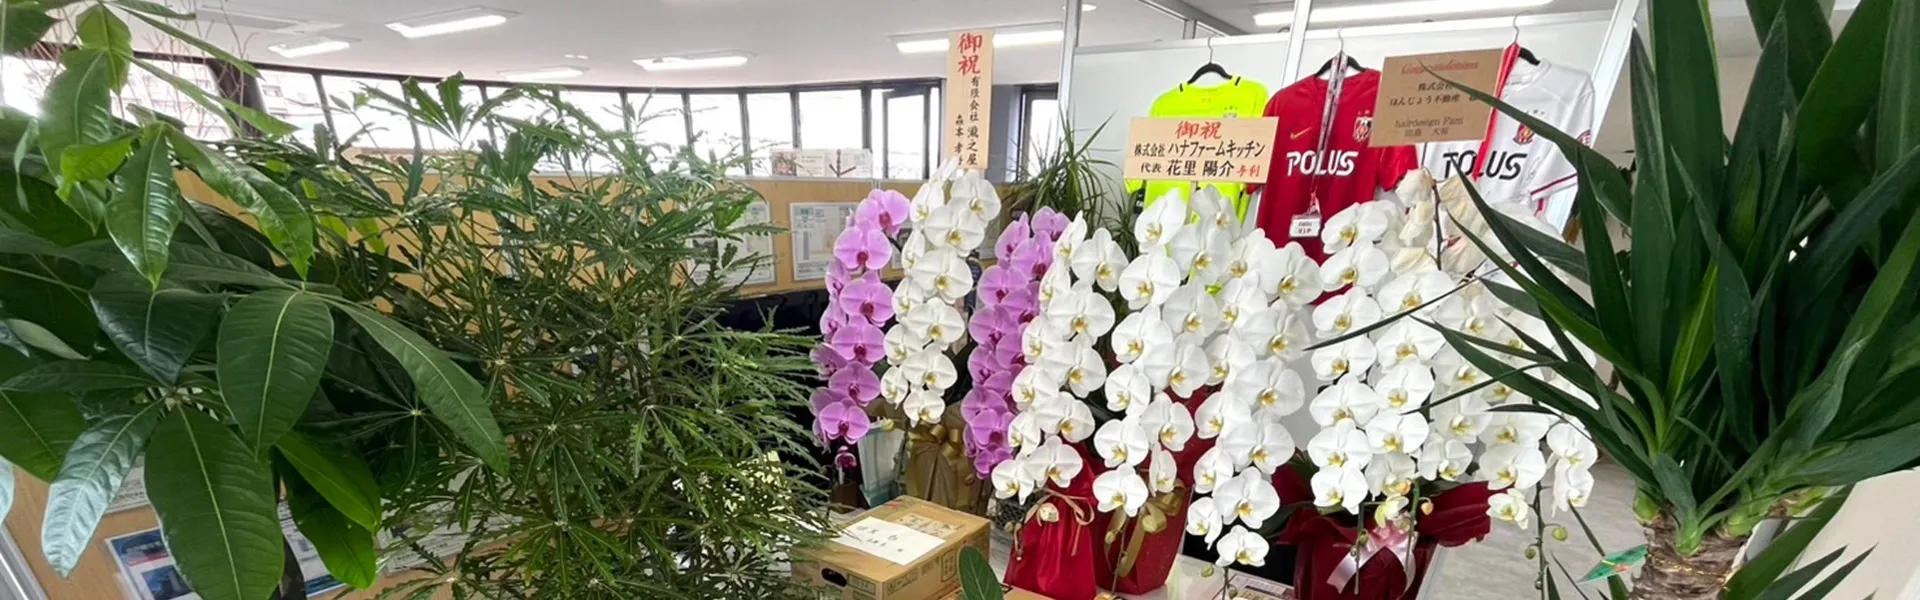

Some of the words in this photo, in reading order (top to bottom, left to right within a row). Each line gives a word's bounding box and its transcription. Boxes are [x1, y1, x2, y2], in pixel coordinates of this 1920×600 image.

[957, 32, 983, 76] 御祝
[969, 76, 981, 121] 有限会社
[1175, 120, 1222, 140] 御祝
[1134, 143, 1165, 157] 株式会社
[1167, 139, 1266, 158] ハナファームキッチン
[1140, 162, 1162, 174] 代表
[1166, 158, 1197, 176] 花里
[1202, 159, 1235, 177] 陽介
[1286, 149, 1359, 176] POLUS
